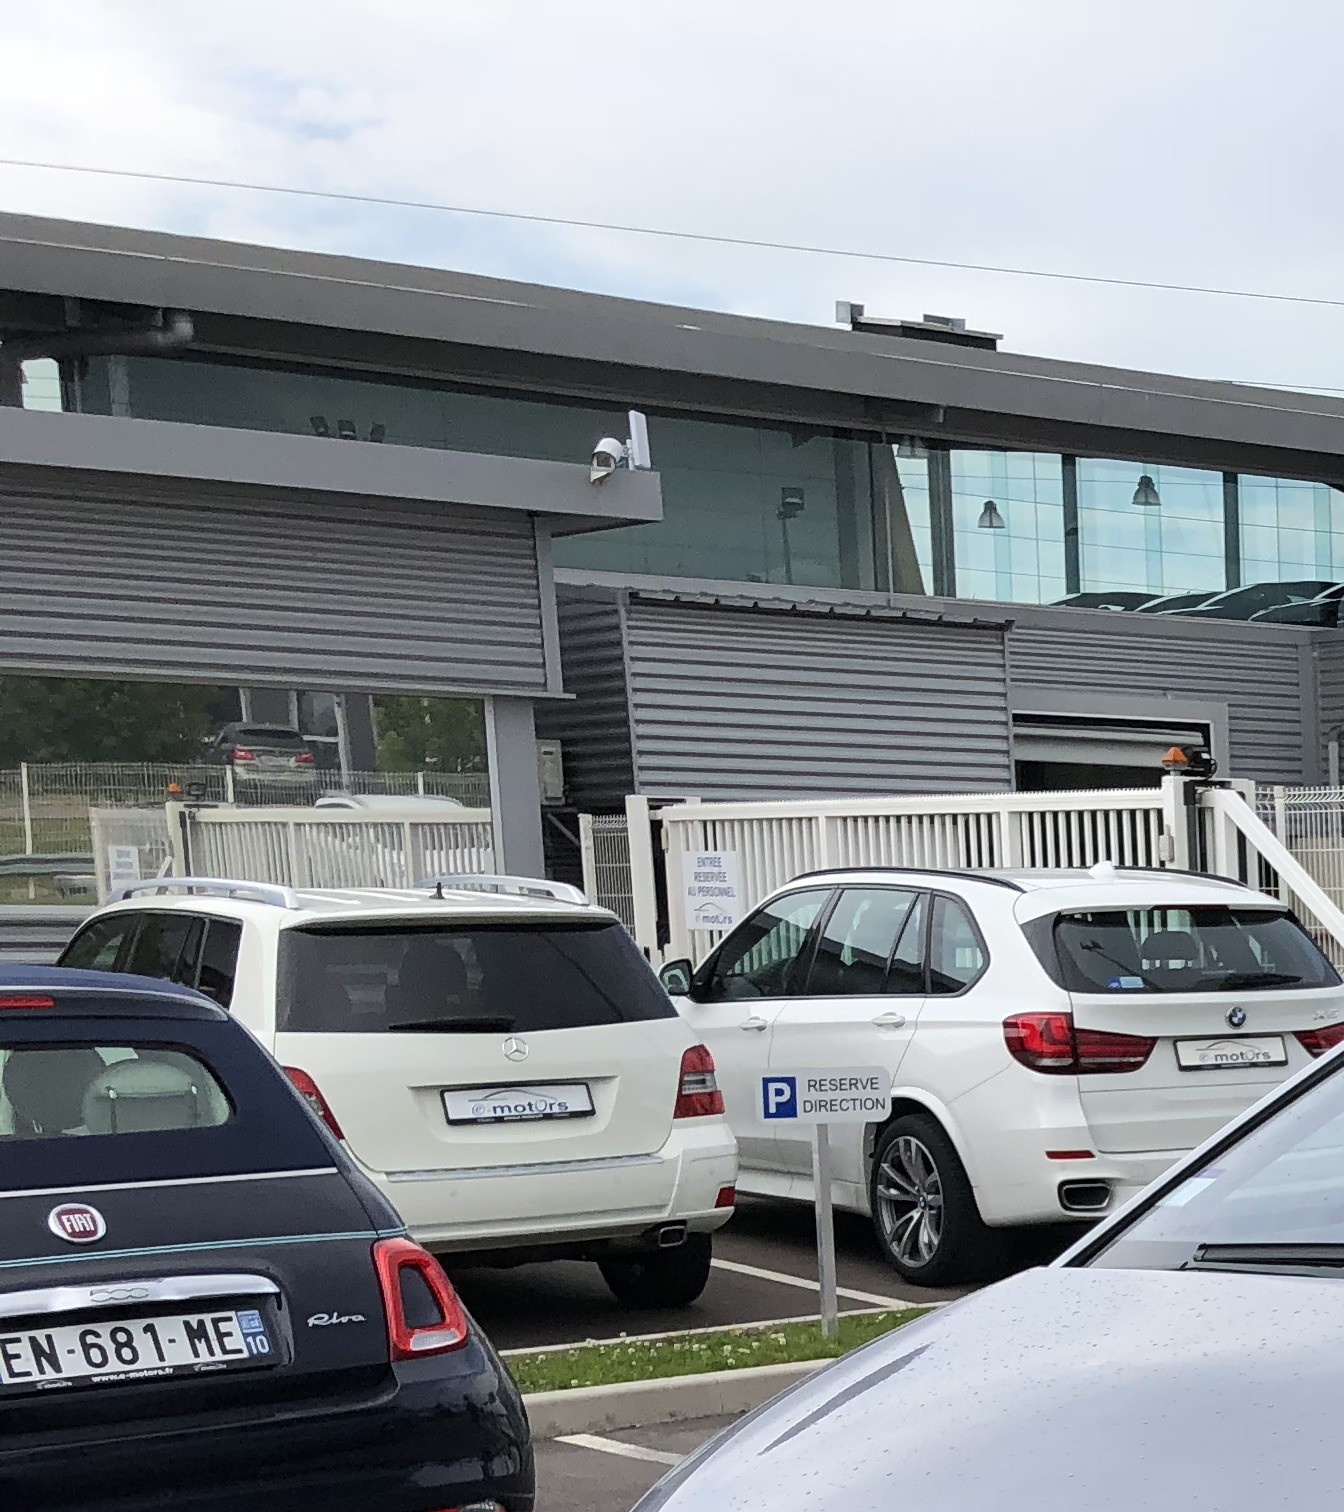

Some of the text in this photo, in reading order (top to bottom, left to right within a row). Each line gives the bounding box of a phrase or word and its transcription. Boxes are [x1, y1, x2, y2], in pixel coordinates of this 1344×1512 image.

[807, 1077, 880, 1093] RESERVE
[803, 1097, 886, 1113] DIRECTION
[61, 1213, 95, 1233] FIAT
[90, 1287, 149, 1301] 500
[246, 1335, 270, 1355] 10
